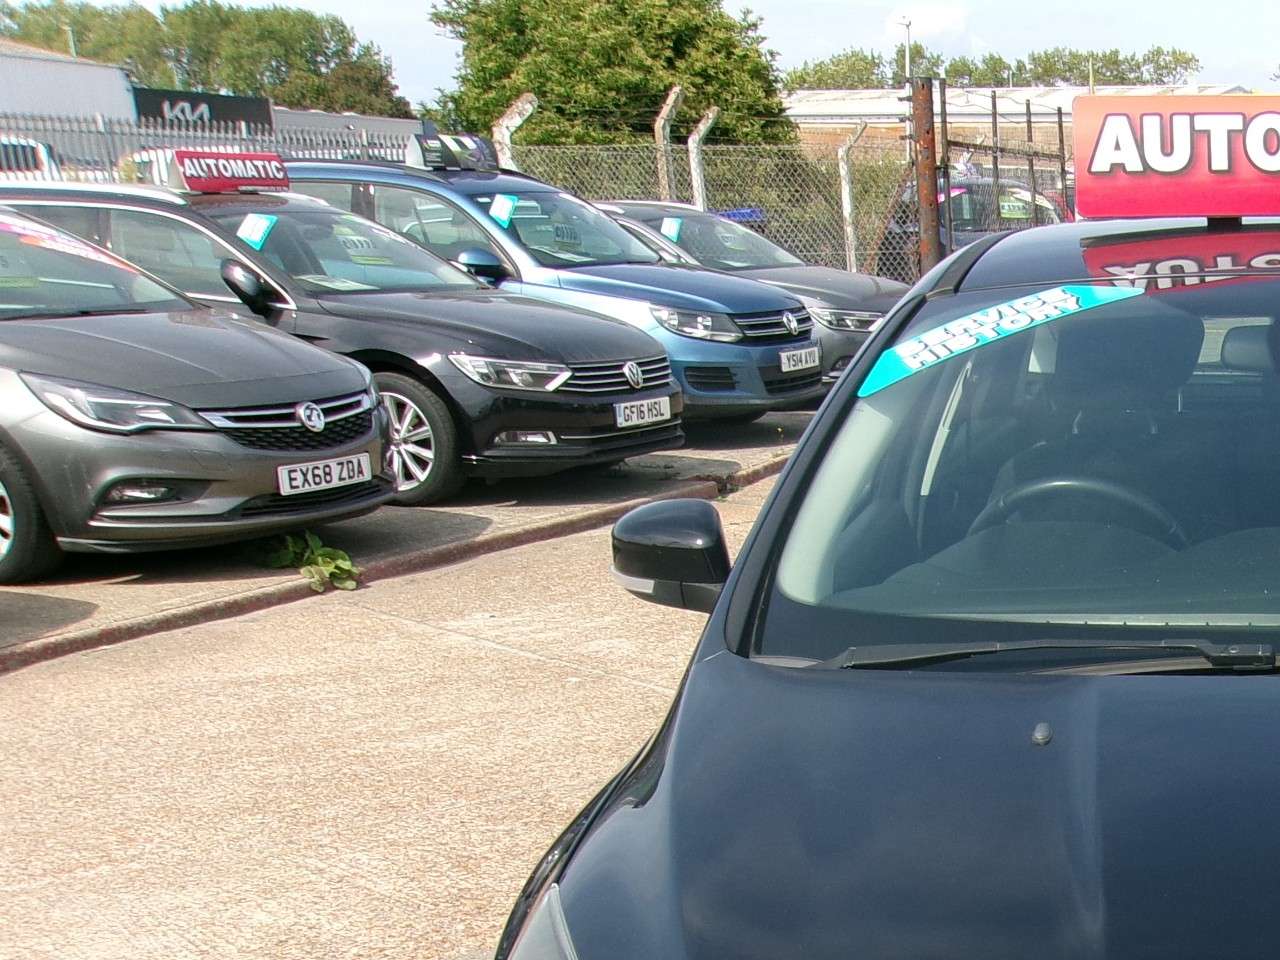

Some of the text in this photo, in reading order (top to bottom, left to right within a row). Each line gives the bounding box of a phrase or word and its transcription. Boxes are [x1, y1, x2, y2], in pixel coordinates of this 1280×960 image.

[183, 157, 284, 179] AUTOMATIC
[623, 400, 664, 422] GF16 HSL
[287, 458, 366, 490] EX68 ZDA
